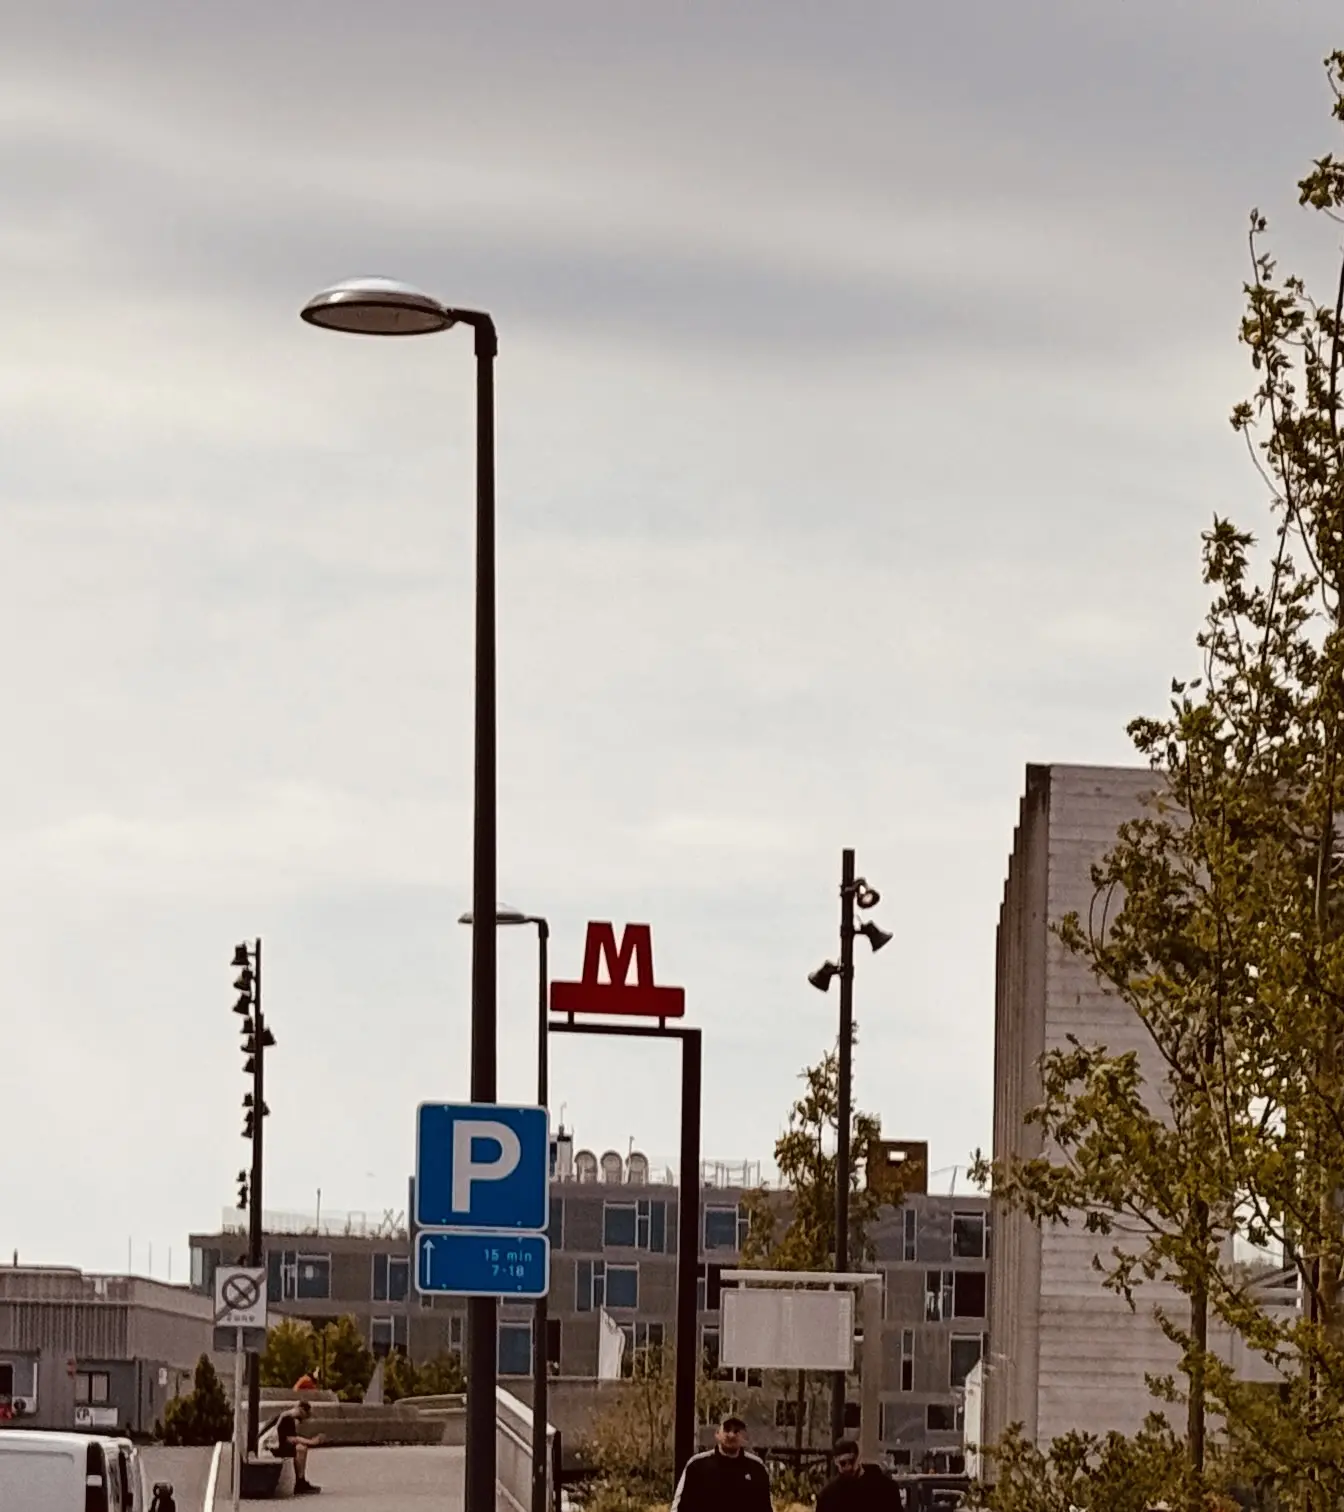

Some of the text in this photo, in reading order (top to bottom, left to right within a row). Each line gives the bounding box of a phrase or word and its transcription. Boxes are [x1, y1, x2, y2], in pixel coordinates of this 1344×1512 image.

[581, 921, 655, 985] M
[452, 1119, 521, 1213] P
[484, 1248, 532, 1262] 15 min
